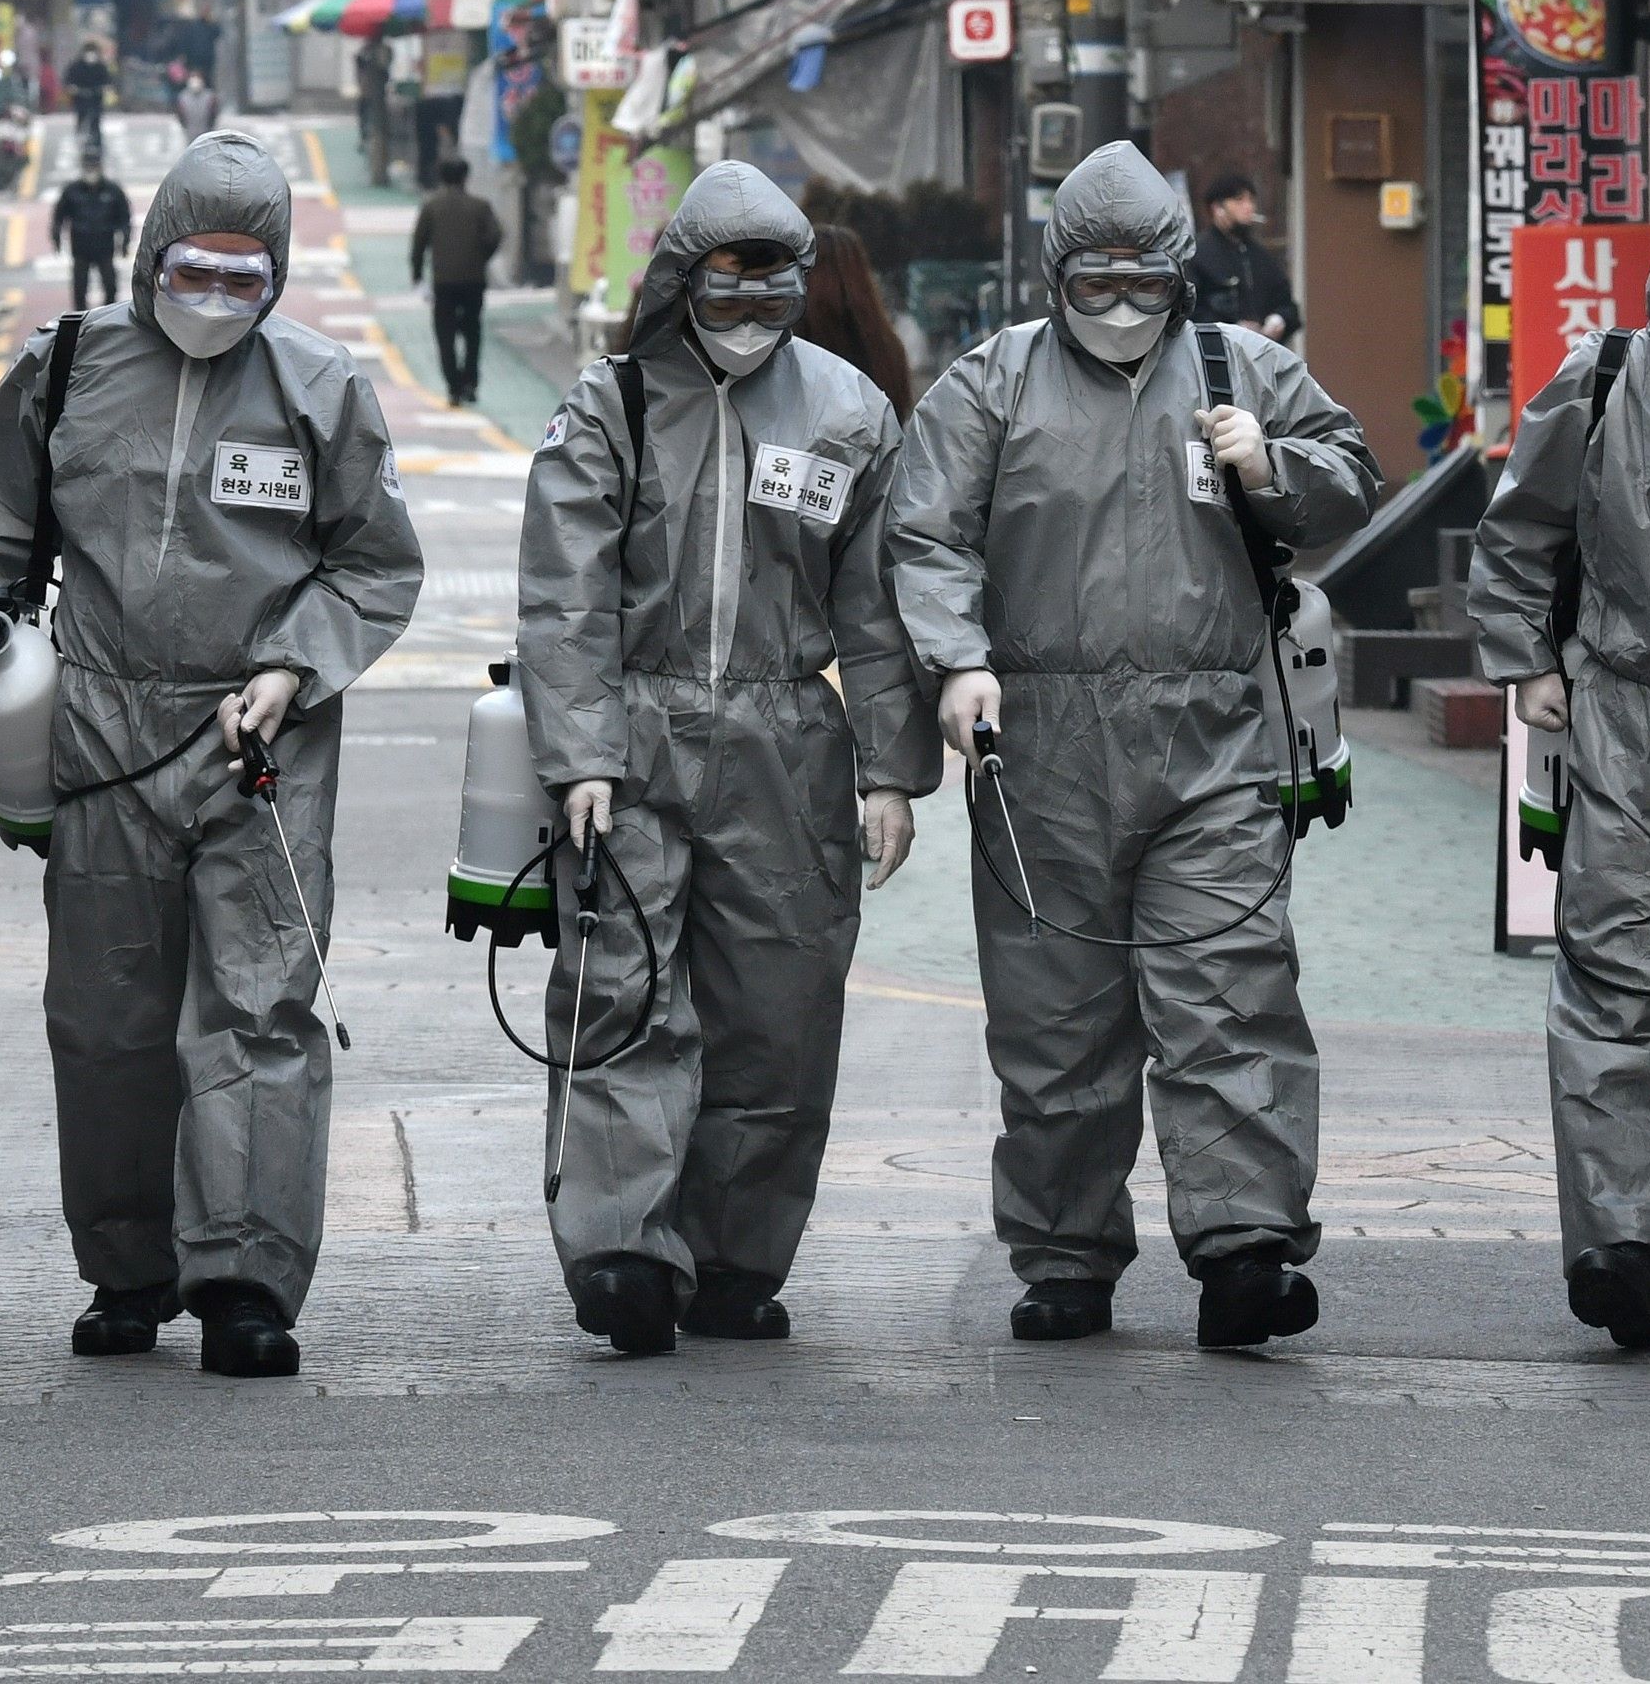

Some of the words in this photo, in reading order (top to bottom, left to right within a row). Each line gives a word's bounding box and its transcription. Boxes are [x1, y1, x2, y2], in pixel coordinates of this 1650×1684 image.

[229, 453, 249, 474] 육
[771, 457, 791, 478] 육
[1202, 454, 1215, 472] 육
[220, 476, 253, 495] 현장
[258, 480, 302, 500] 지원팀
[760, 479, 793, 499] 현장
[797, 487, 833, 512] 지원팀
[1196, 476, 1219, 494] 현장
